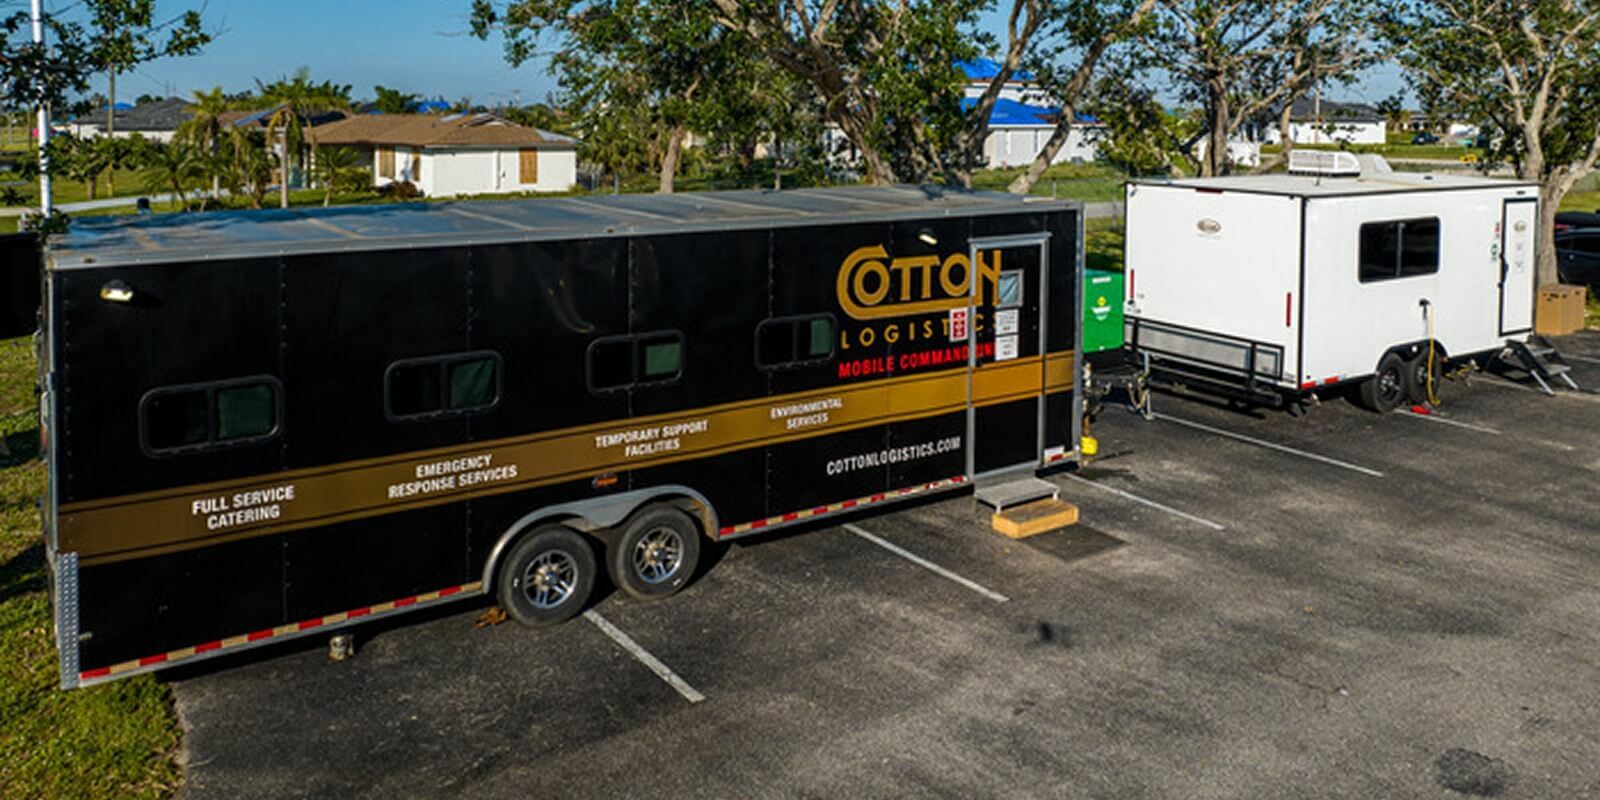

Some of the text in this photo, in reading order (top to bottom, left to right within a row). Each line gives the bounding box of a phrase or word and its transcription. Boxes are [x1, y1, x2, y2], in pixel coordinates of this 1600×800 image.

[840, 312, 996, 349] LOGISTC
[838, 356, 895, 378] MOBILE
[900, 344, 970, 369] COMMAND
[770, 397, 843, 419] ENVIRONMENTAL
[786, 411, 828, 430] SERVICES
[595, 419, 708, 448] TEMPORARY SUPPORT
[624, 438, 680, 457] FACILITIES
[415, 453, 492, 478] EMERGENCY
[826, 436, 961, 475] COTTONLOGISTICS.COM
[387, 464, 518, 498] RESPONSE SERVICES
[192, 484, 295, 515] FULL SERVICE
[207, 504, 280, 530] CATERING
